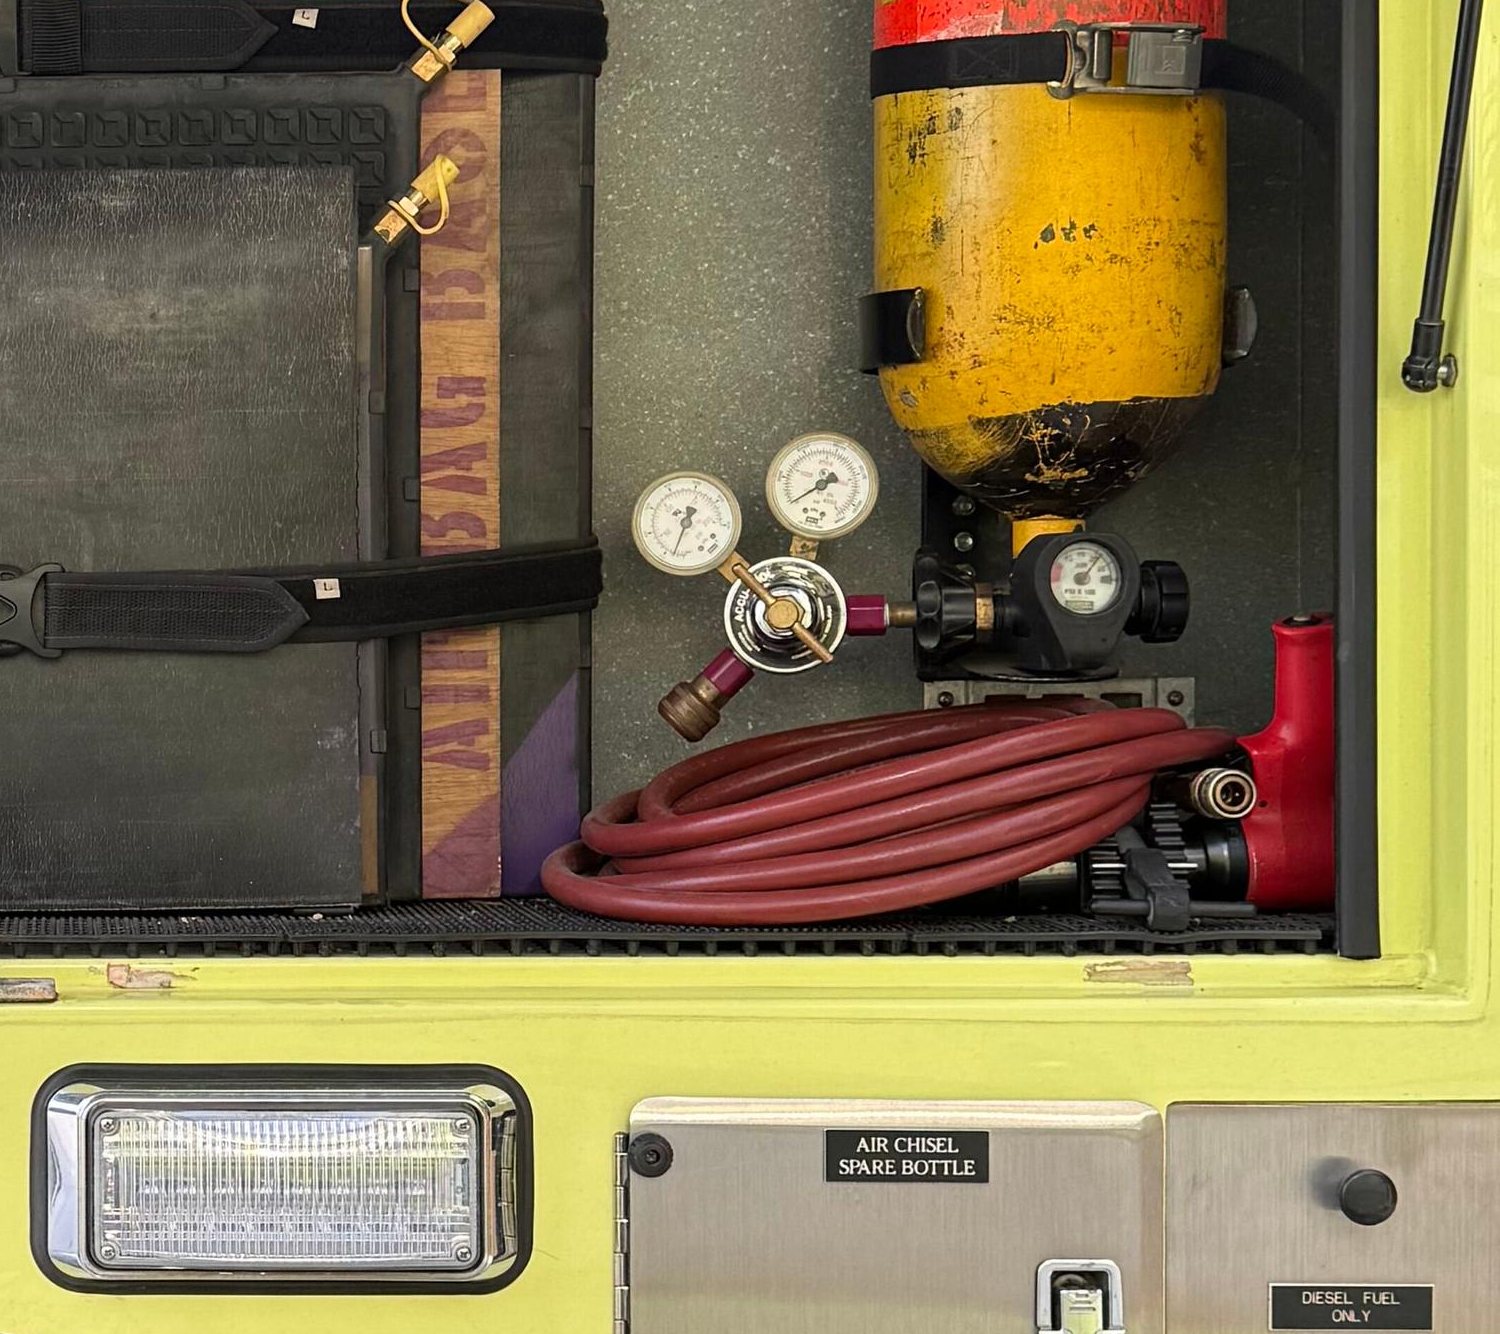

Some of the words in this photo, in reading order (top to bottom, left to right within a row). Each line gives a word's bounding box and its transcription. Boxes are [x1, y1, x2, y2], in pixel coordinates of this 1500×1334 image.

[856, 1136, 889, 1153] AIR
[894, 1137, 959, 1154] CHISEL
[838, 1158, 897, 1176] SPARE
[901, 1159, 976, 1176] BOTTLE
[1301, 1291, 1353, 1305] DIESEL
[1363, 1291, 1401, 1305] FUEL
[1331, 1309, 1371, 1323] ONLY
